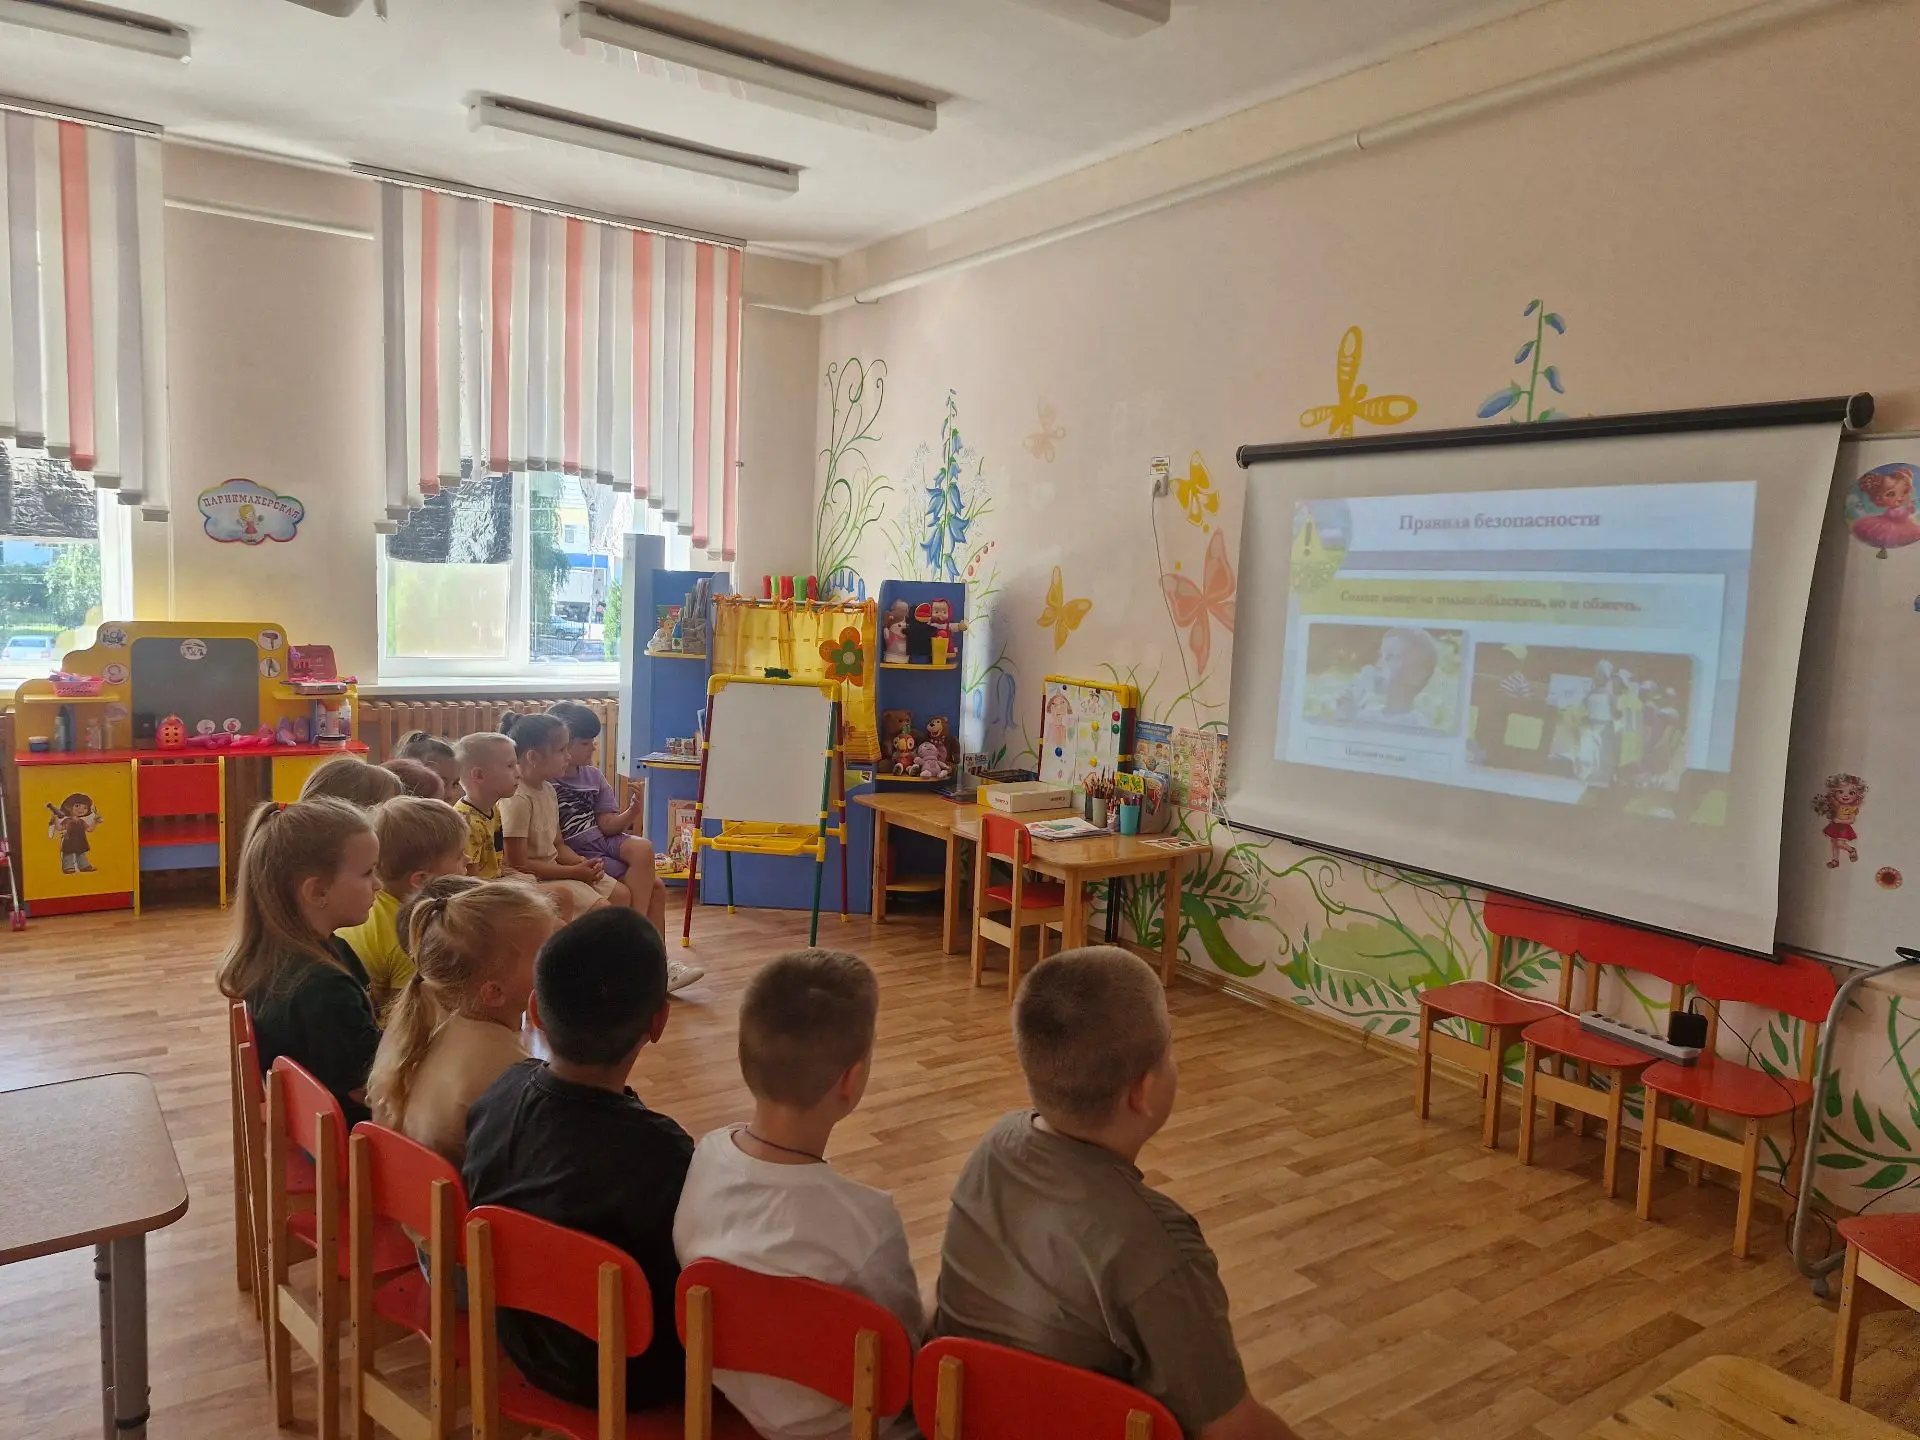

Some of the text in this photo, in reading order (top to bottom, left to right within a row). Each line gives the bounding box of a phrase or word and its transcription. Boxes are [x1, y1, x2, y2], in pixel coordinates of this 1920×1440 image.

[202, 494, 300, 519] ПАРИКМАХЕРСКАЯ
[1398, 512, 1601, 536] Правила безопасности
